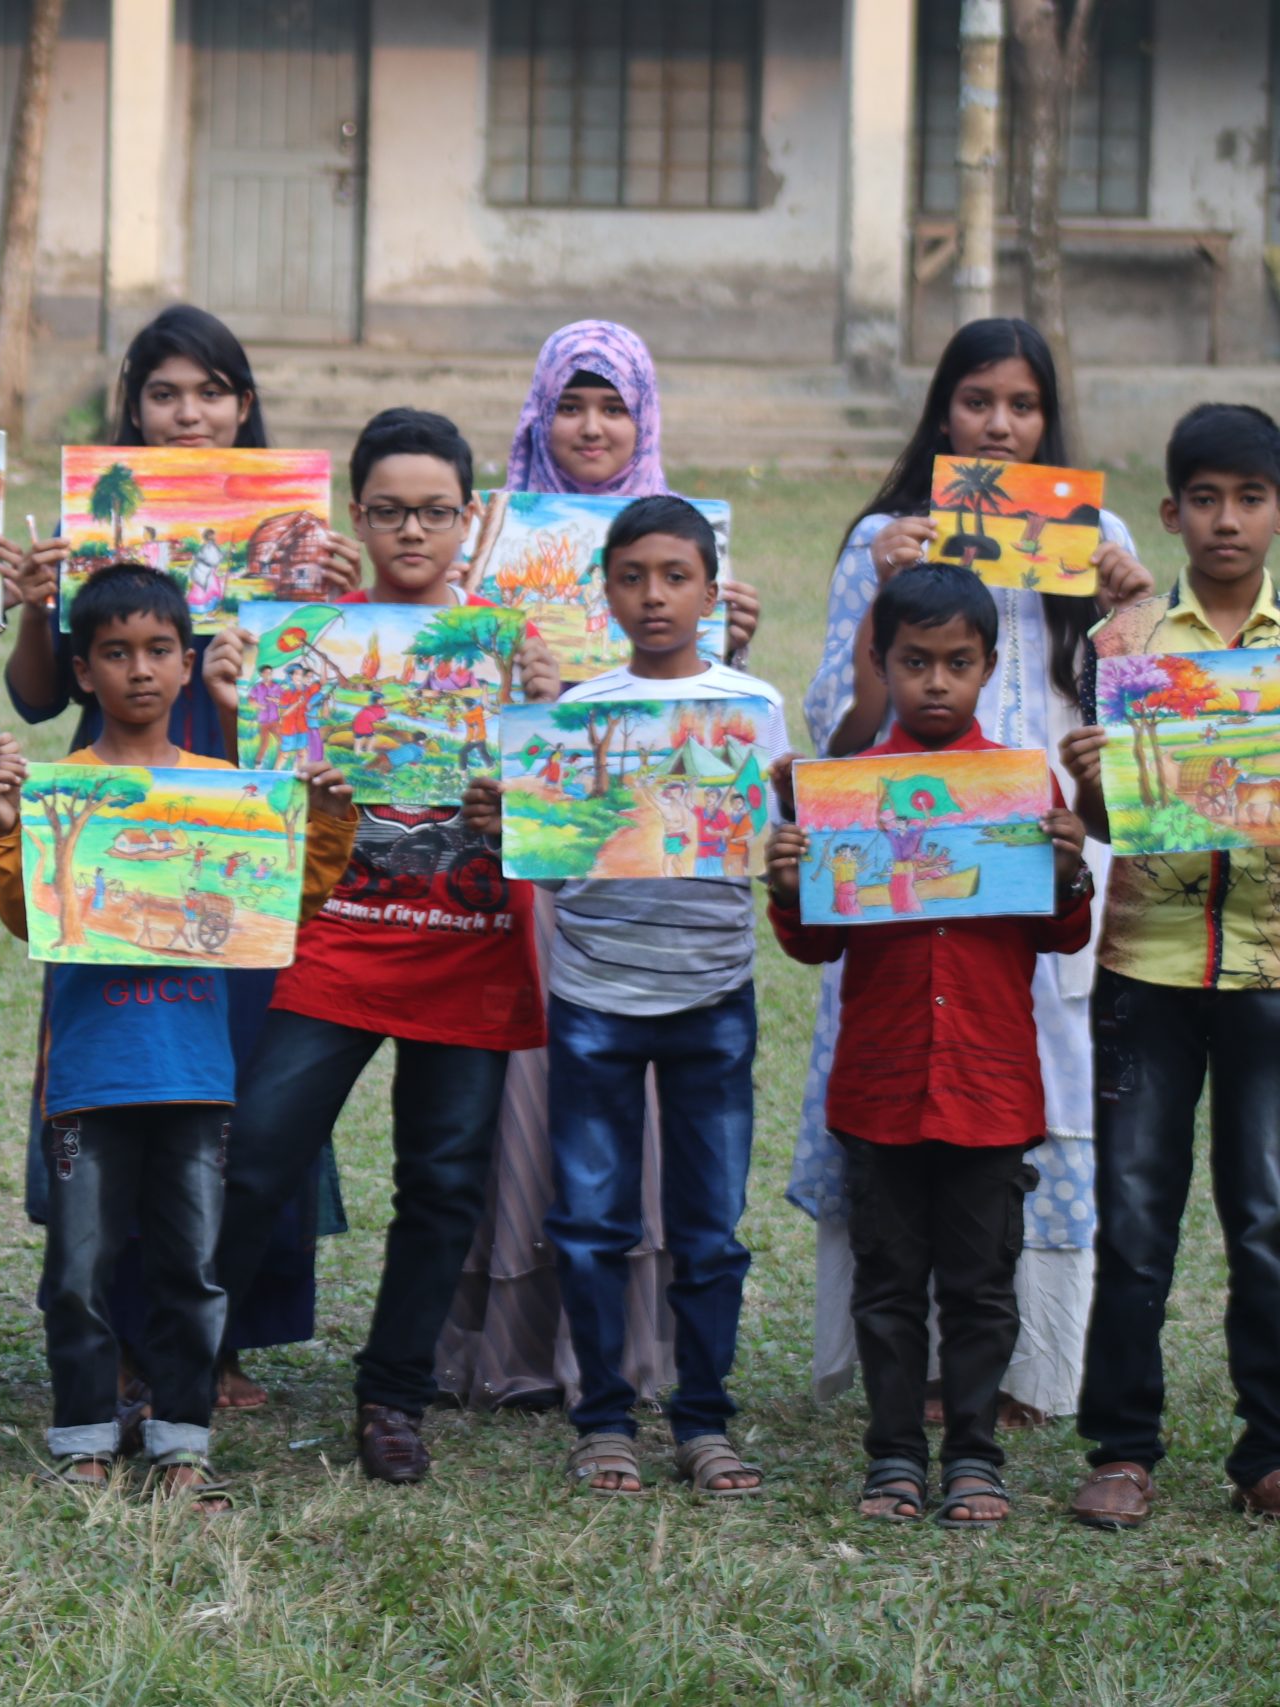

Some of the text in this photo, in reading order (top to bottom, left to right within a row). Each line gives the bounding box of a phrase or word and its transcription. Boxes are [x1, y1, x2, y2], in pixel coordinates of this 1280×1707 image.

[322, 898, 381, 924] anama
[383, 903, 426, 931] City
[102, 975, 216, 1006] GUCCI
